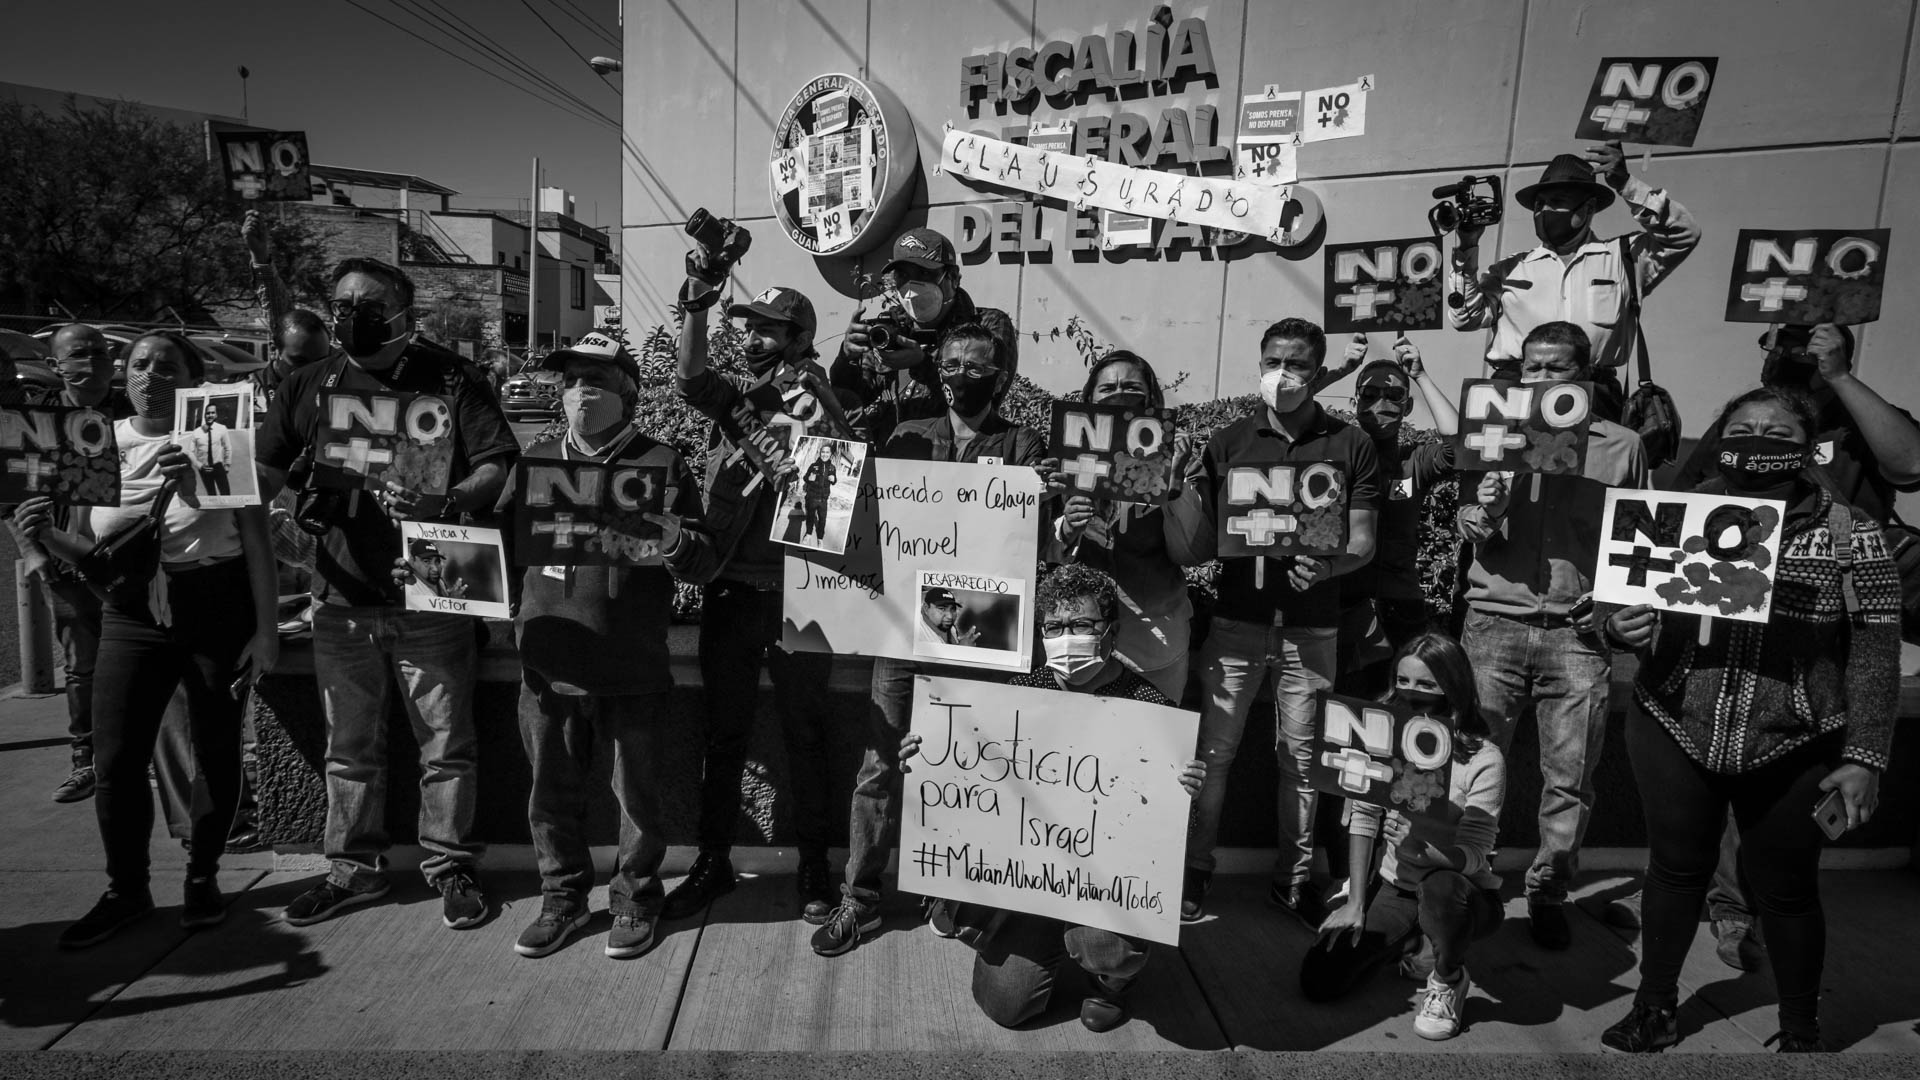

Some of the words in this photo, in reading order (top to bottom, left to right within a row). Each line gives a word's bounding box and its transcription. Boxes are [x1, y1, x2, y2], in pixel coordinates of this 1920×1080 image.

[796, 77, 843, 107] GENERAL
[1318, 92, 1350, 112] NO
[1600, 61, 1710, 111] NO
[1248, 121, 1257, 129] NO
[226, 140, 301, 177] NO
[779, 156, 796, 174] NO
[1251, 144, 1281, 164] NO
[823, 211, 841, 229] NO
[955, 201, 1052, 253] DEL
[1334, 243, 1443, 285] NO
[1747, 236, 1881, 279] NO
[329, 395, 451, 446] NO
[1464, 382, 1590, 428] NO
[0, 406, 113, 457] NO
[1063, 411, 1165, 458] NO
[526, 466, 656, 512] NO
[957, 488, 978, 502] en
[985, 477, 1036, 519] Celaya
[1228, 463, 1344, 510] NO
[417, 523, 457, 539] Justicia
[875, 520, 958, 560] Manuel
[1611, 499, 1762, 562] NO
[796, 550, 884, 600] Jiménez
[923, 573, 1009, 593] DESAPARECIDO
[920, 702, 1109, 796] Justicia
[1323, 700, 1452, 770] NO
[920, 780, 1000, 827] para
[1020, 796, 1097, 858] Israel
